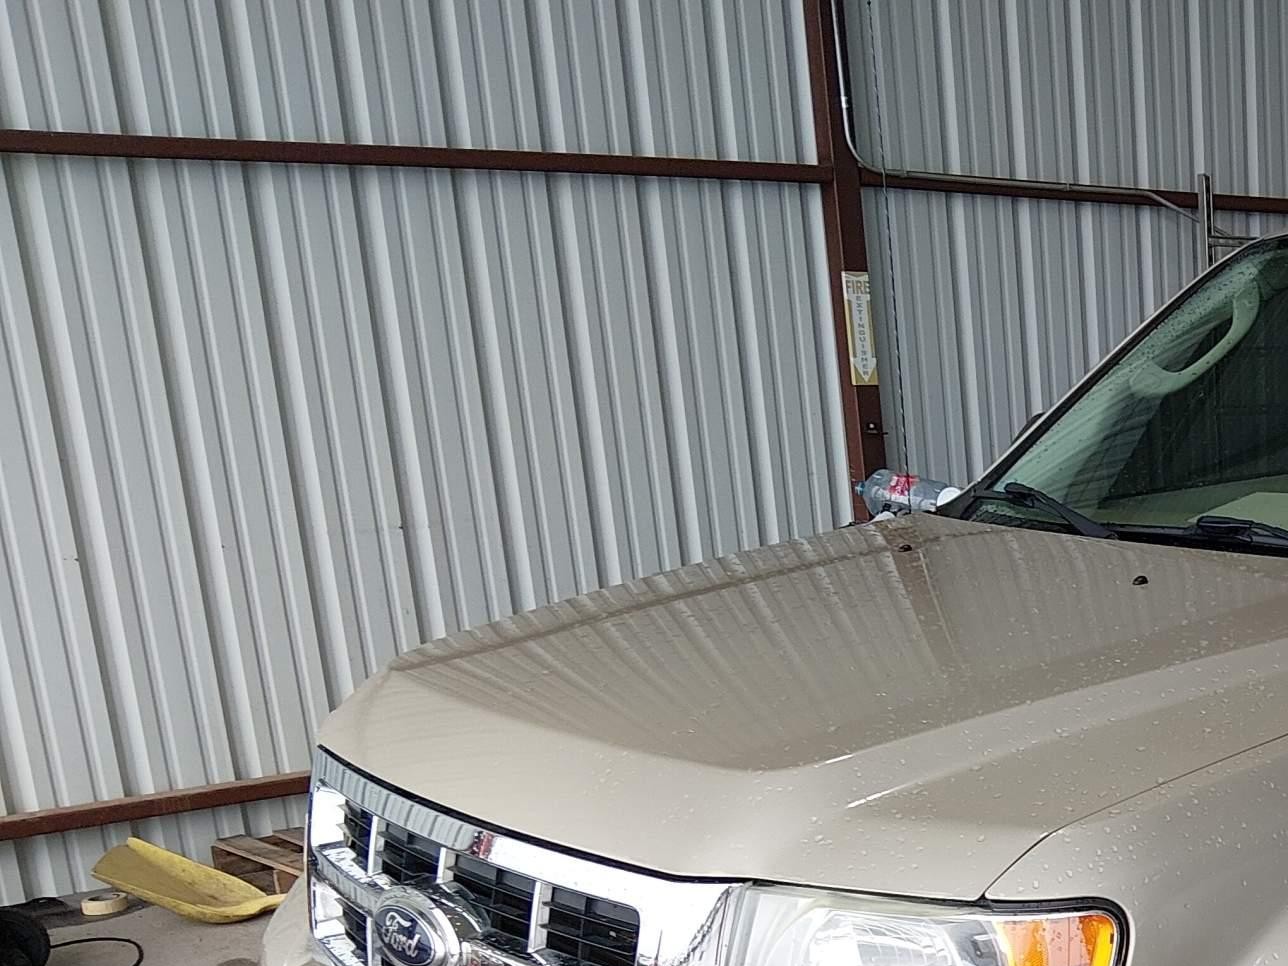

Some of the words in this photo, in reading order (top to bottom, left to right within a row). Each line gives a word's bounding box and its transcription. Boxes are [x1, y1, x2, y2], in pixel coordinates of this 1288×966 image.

[846, 280, 871, 294] FIRE
[855, 295, 869, 376] EXTINGUISHER
[382, 911, 421, 957] Ford
